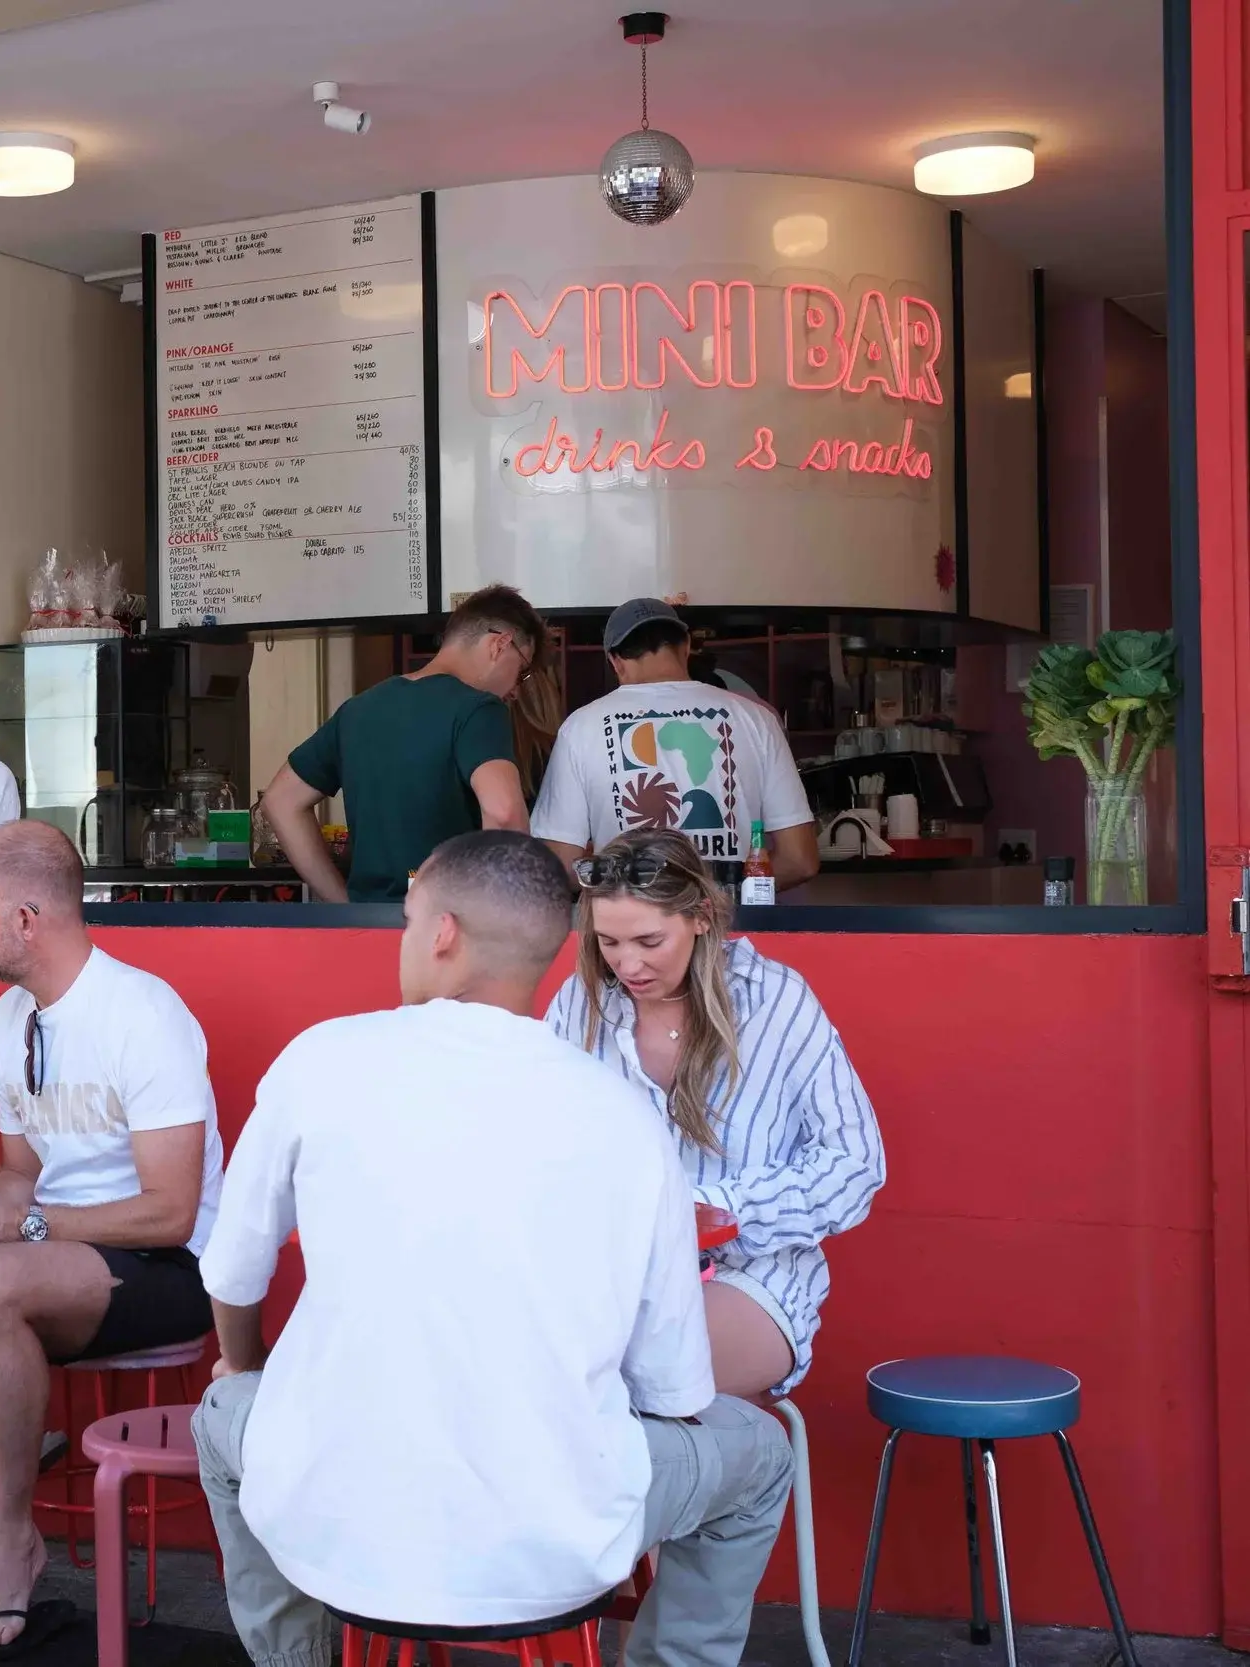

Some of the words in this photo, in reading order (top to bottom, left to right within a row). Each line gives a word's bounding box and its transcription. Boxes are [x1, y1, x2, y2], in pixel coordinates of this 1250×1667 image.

[164, 230, 181, 241] RED
[165, 279, 194, 290] WHITE
[484, 280, 756, 398] MINI
[784, 285, 944, 405] BAR
[166, 343, 235, 359] PINK/ORANGE
[168, 405, 219, 419] SPARKLING
[514, 408, 705, 478] drinks
[799, 417, 932, 481] snacks
[166, 453, 219, 467] BEER/CIDER
[168, 469, 176, 478] ST
[180, 465, 208, 476] FRANCIS
[213, 461, 236, 472] BEACH
[239, 460, 268, 470] BLONDE
[275, 460, 284, 468] ON
[290, 458, 305, 467] TAP
[195, 473, 218, 482] LAGER
[232, 478, 252, 487] LOVES
[255, 477, 281, 486] CANDY
[287, 475, 300, 484] IPA
[407, 479, 418, 487] 60
[185, 490, 200, 499] LITE
[203, 488, 227, 498] LAGER
[407, 487, 418, 496] 40
[199, 498, 214, 507] CAN
[196, 504, 212, 514] PEAK
[220, 503, 236, 512] HERO
[169, 516, 184, 525] JACK
[187, 512, 208, 522] BLACK
[212, 510, 254, 522] SUPERCRUSH
[303, 507, 313, 516] OR
[316, 504, 343, 515] CHERRY
[348, 504, 362, 514] ALE
[197, 518, 217, 528] CIDER
[168, 532, 219, 546] COCKTAILS
[223, 531, 242, 541] BOMB
[305, 538, 327, 548] DOUBLE
[170, 547, 197, 557] APEROL
[202, 544, 228, 553] SPRITZ
[353, 545, 366, 555] 125
[169, 556, 198, 566] PALOMA
[169, 563, 216, 574] COSMOPOLITAN
[170, 572, 196, 582] FROZEN
[200, 569, 241, 580] MARGARITA
[170, 581, 201, 591] NEGRONI
[410, 581, 423, 590] 120
[170, 590, 198, 599] MEZCAL
[203, 587, 235, 596] NEGRONI
[171, 598, 197, 607] FROZEN
[204, 596, 226, 605] DIRTY
[232, 593, 262, 604] SHIRLEY
[171, 606, 192, 616] DIRTY
[196, 606, 226, 615] MARTINI
[603, 714, 618, 775] SOUTH
[612, 781, 624, 832] AFRI
[694, 831, 738, 857] URL
